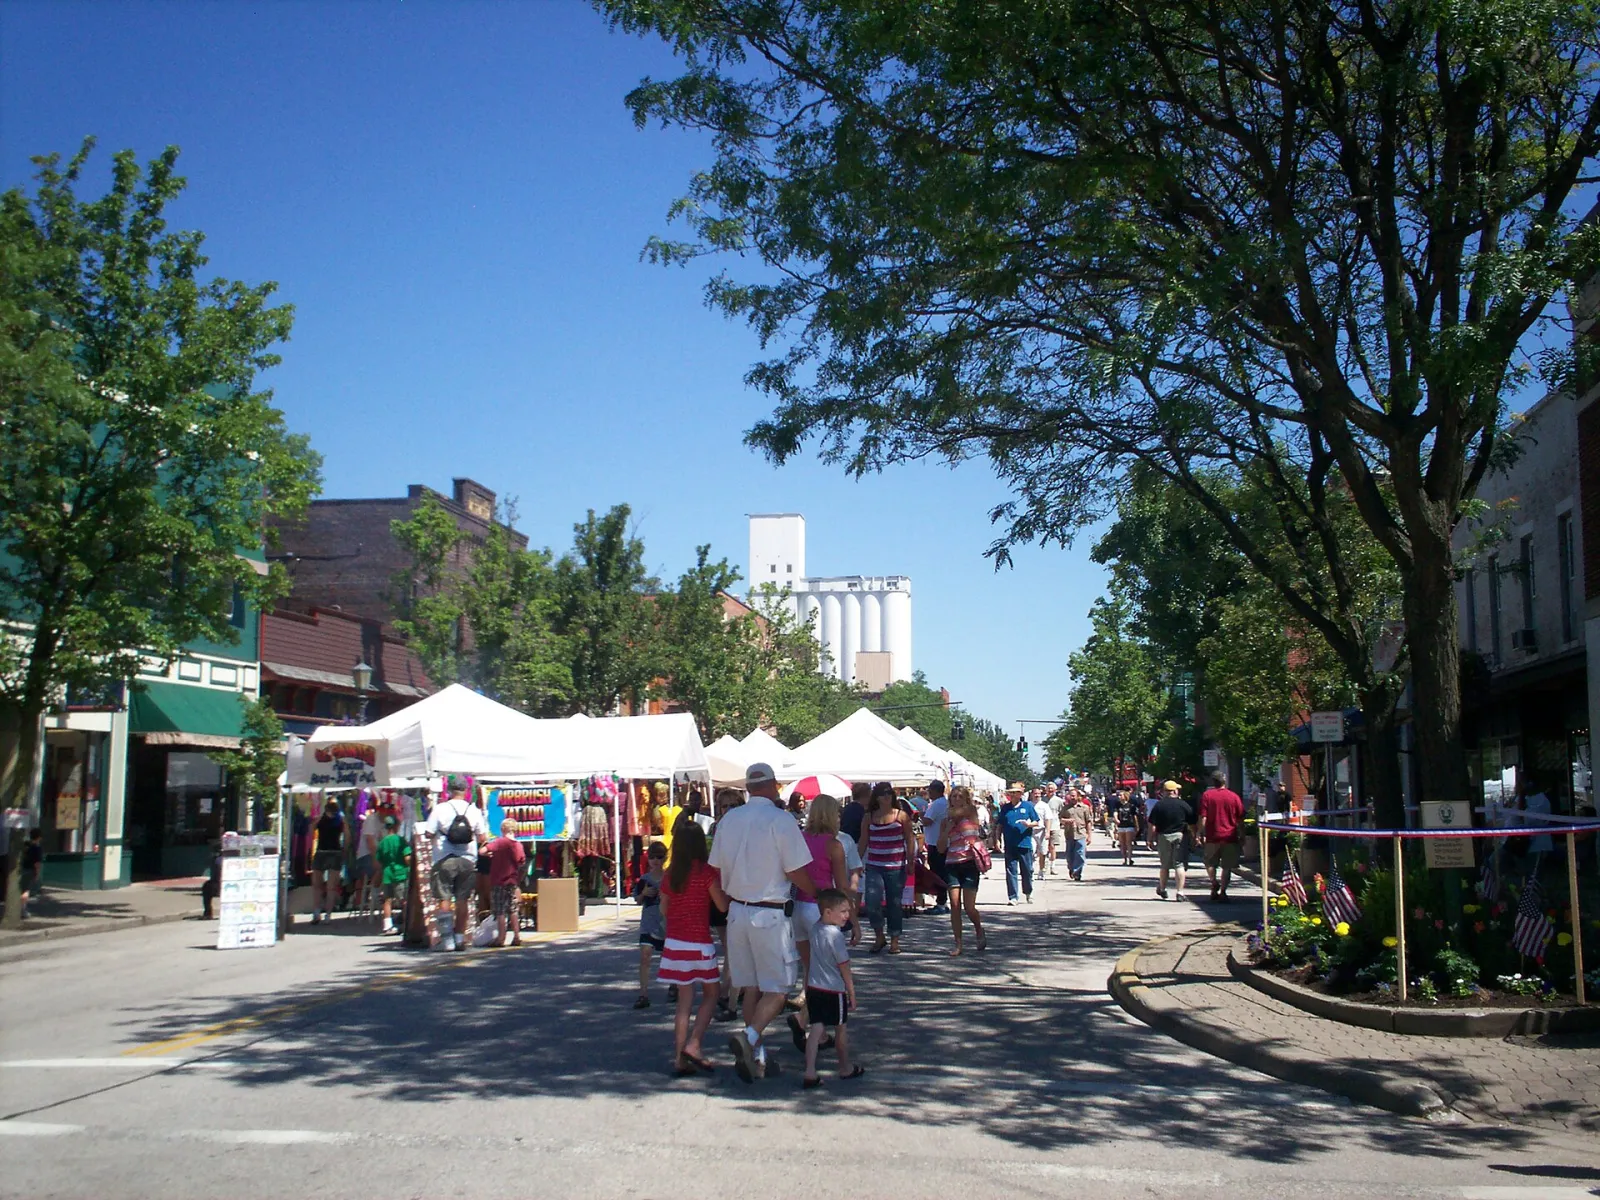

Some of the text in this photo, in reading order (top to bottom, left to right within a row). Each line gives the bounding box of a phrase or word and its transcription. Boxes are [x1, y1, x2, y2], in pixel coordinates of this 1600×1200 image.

[497, 788, 552, 806] AIRBRUSH
[502, 804, 545, 822] TATTOO
[516, 820, 545, 837] UDIO
